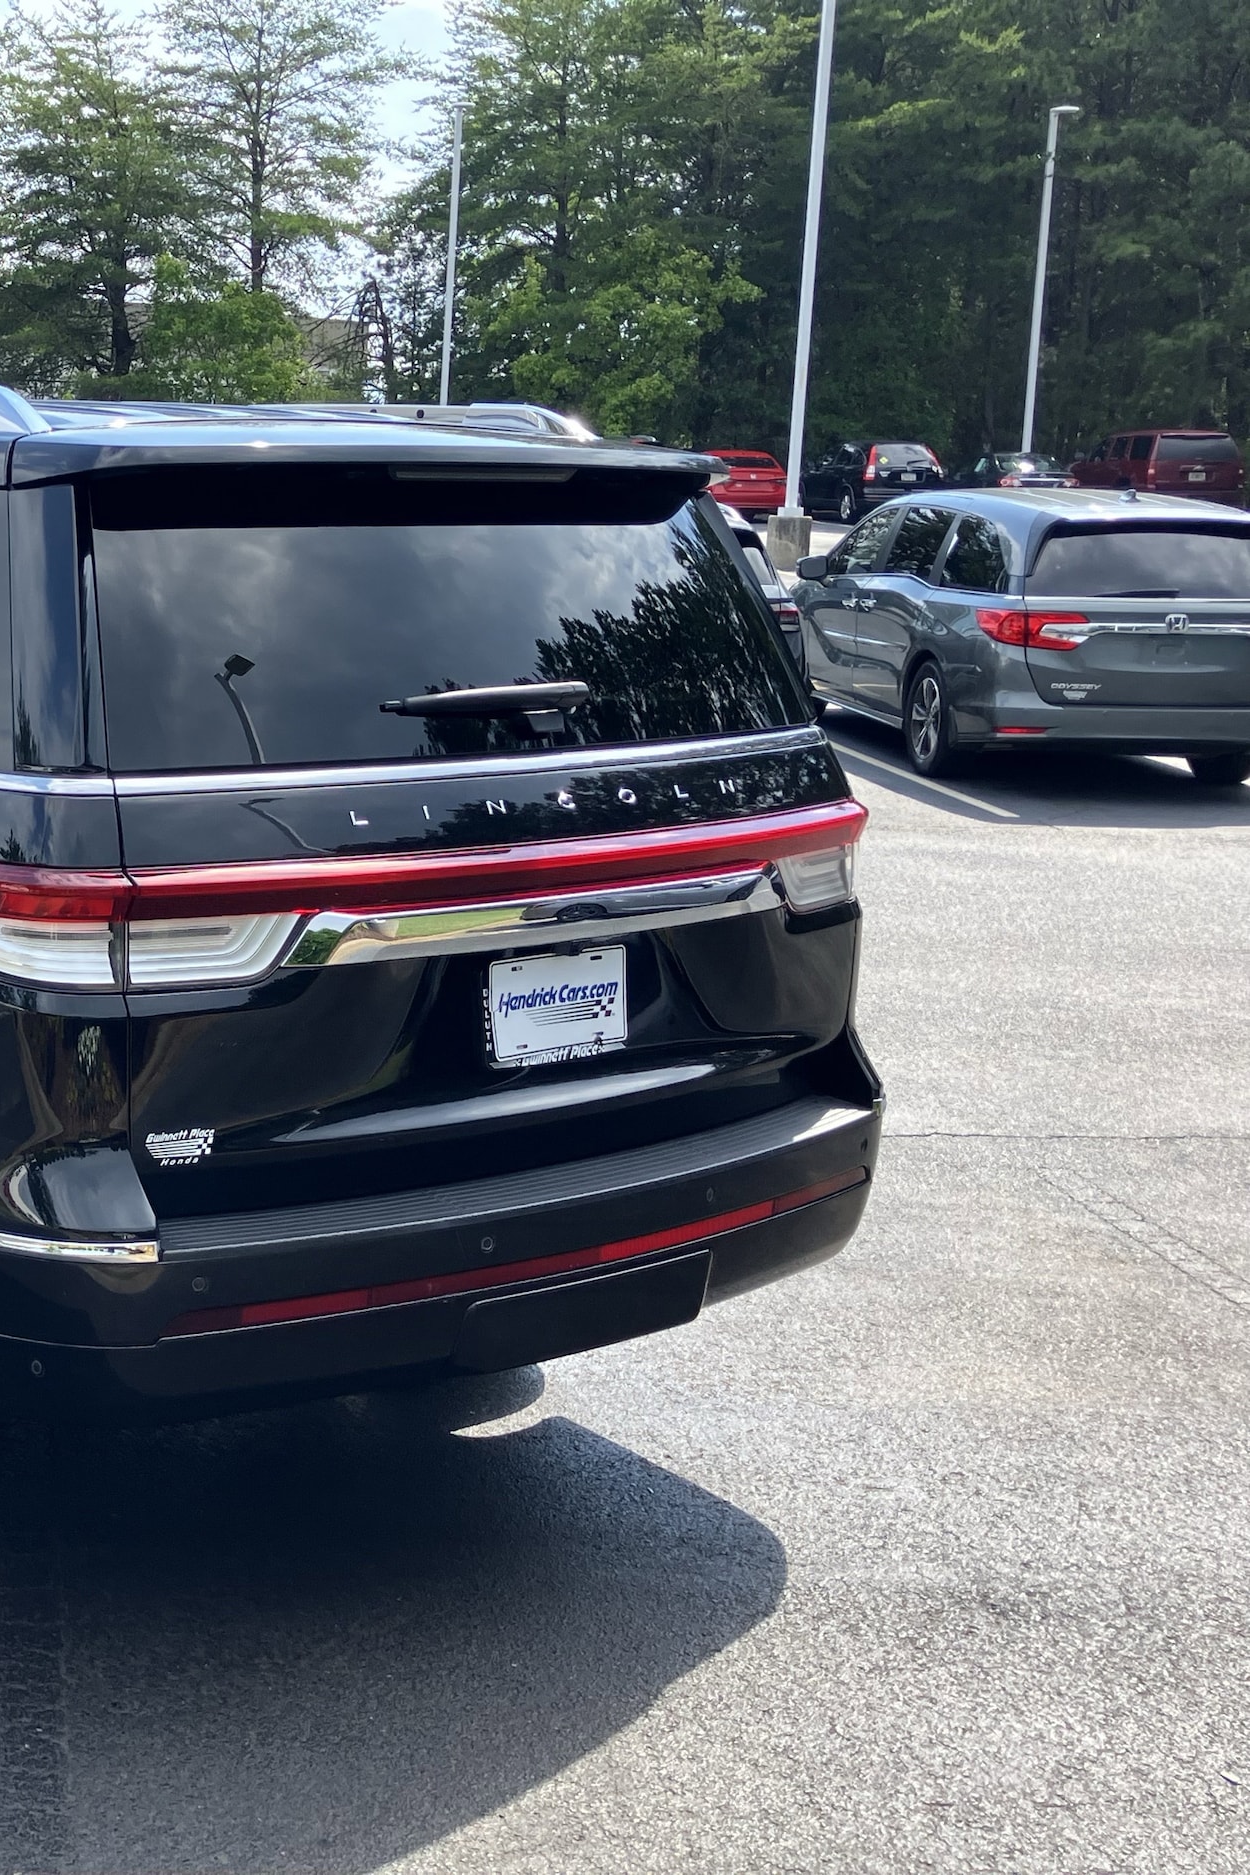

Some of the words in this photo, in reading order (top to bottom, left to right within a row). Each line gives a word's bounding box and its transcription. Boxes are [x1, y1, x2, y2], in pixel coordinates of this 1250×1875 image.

[1050, 683, 1102, 691] ODYSSEY
[349, 778, 737, 827] LINCOLN
[482, 988, 493, 1052] DULUTH
[569, 1043, 599, 1060] Place
[145, 1129, 188, 1144] Gwinnett
[188, 1127, 216, 1139] Place
[159, 1157, 200, 1167] Honda
